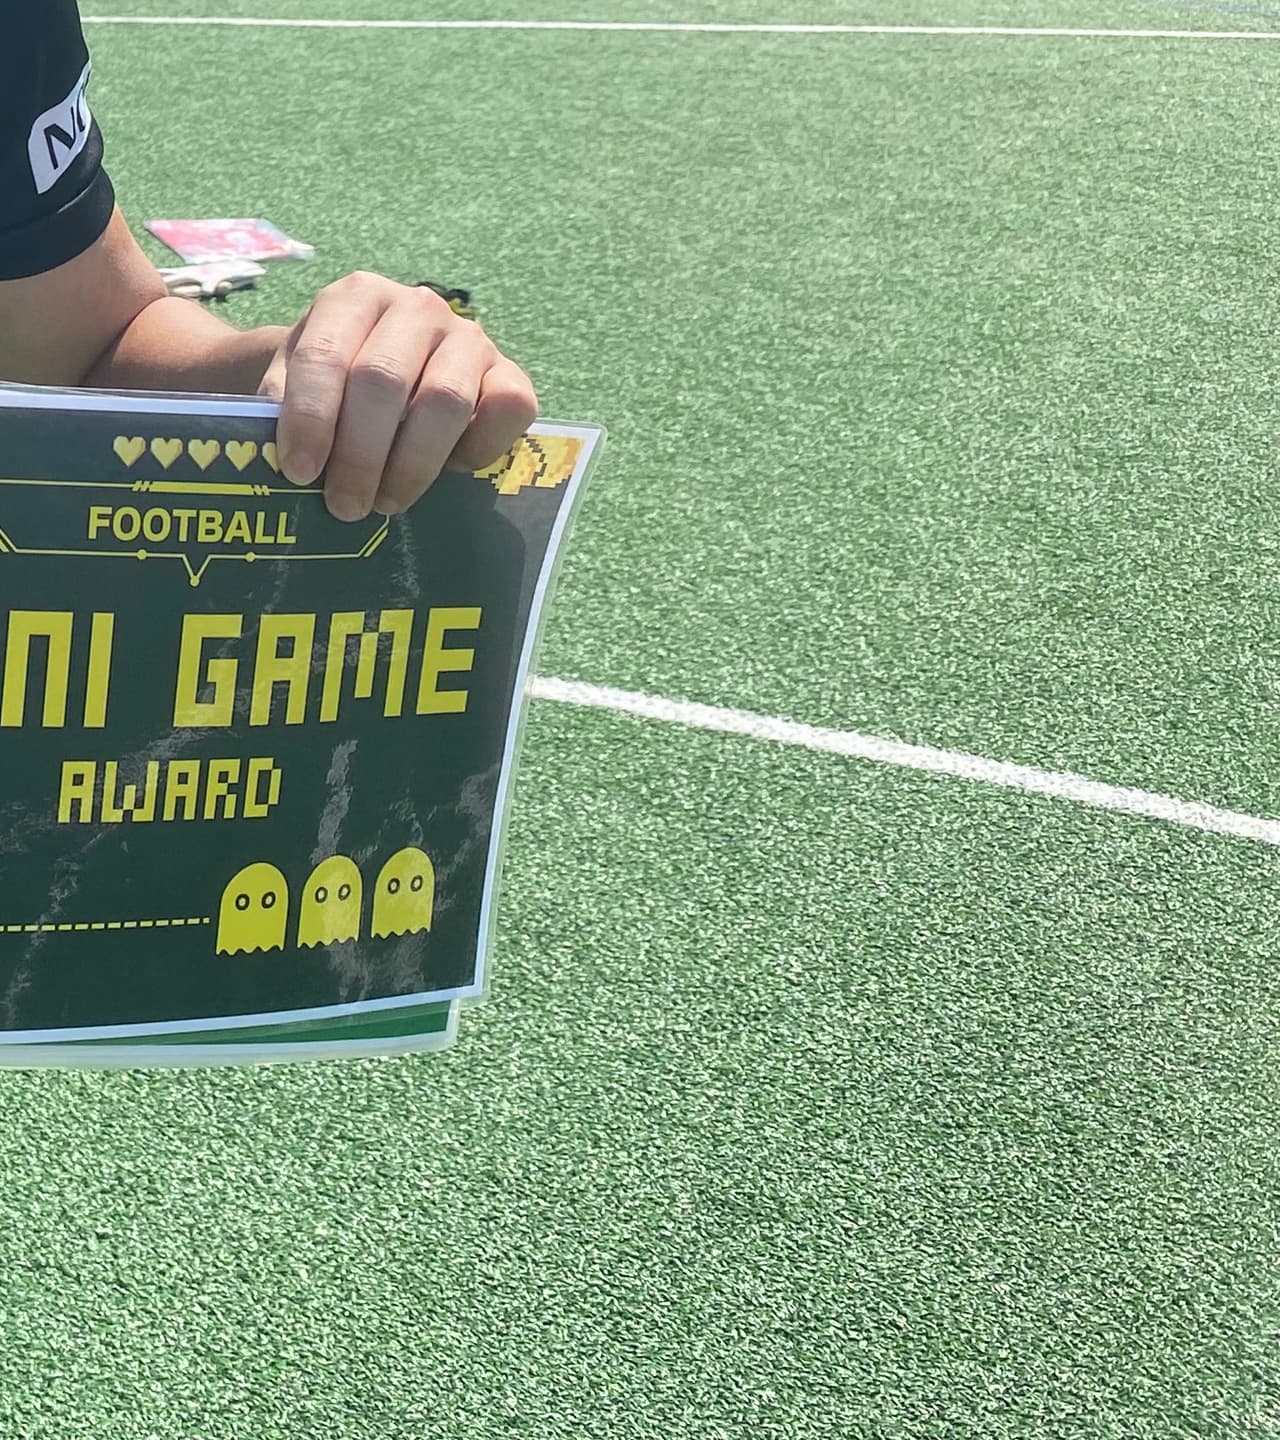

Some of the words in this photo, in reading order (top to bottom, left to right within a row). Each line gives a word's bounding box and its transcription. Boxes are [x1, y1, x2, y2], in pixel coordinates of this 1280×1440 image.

[86, 506, 298, 545] FOOTBALL
[173, 606, 484, 729] GAME
[57, 756, 283, 824] AWARD
